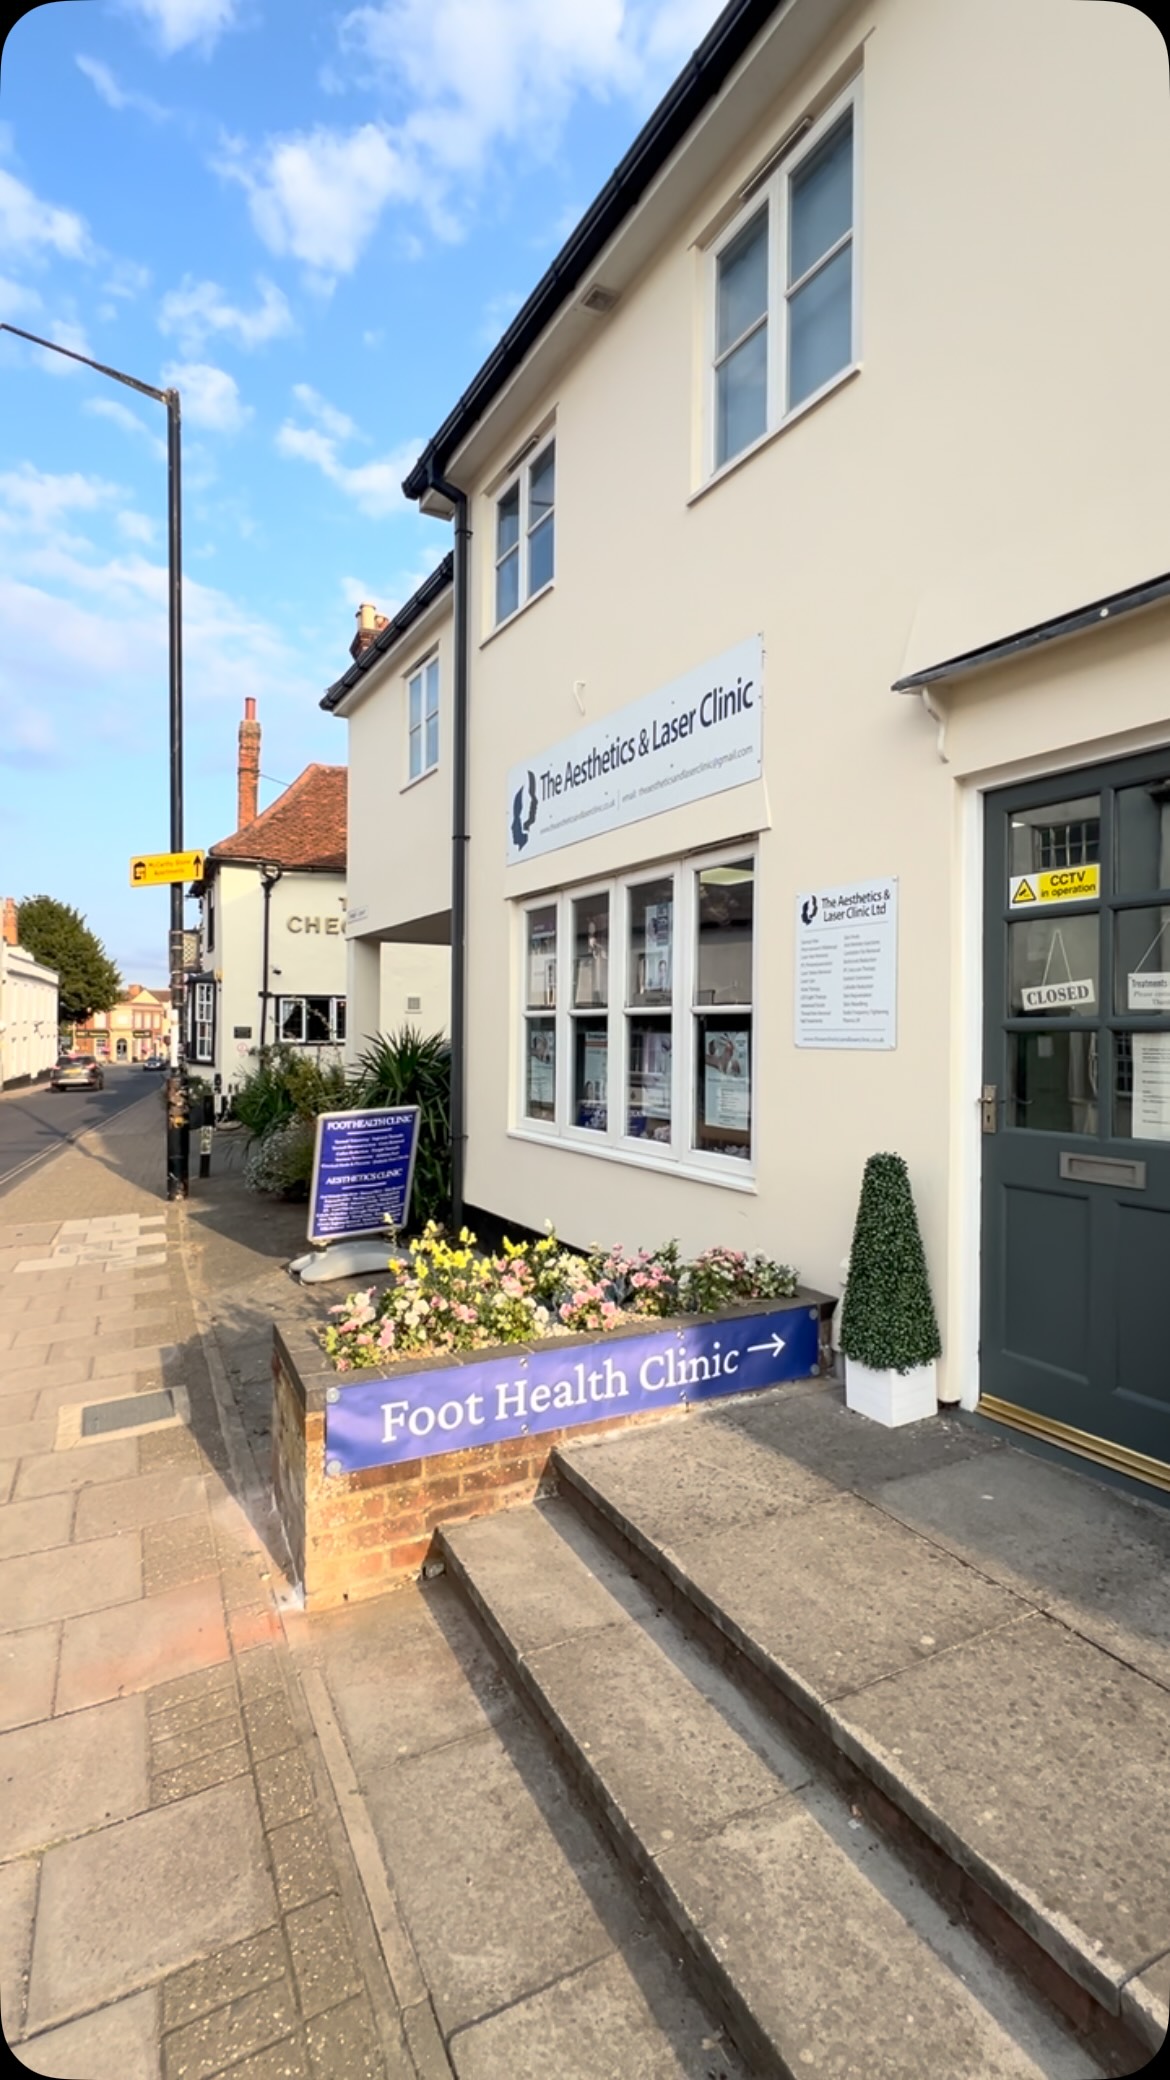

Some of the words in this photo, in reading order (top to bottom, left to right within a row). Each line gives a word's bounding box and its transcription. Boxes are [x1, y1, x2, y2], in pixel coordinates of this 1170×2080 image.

[540, 770, 562, 802] The
[564, 736, 635, 792] Aesthetics
[638, 728, 650, 757] &
[652, 707, 697, 751] Laser
[699, 677, 754, 728] Clinic
[1050, 871, 1086, 886] CCTV
[821, 896, 836, 909] The
[838, 890, 882, 906] Aesthetics
[884, 888, 890, 900] &
[1041, 888, 1049, 897] in
[1051, 883, 1096, 897] operation
[823, 911, 845, 922] Laser
[846, 905, 870, 919] Clinic
[871, 901, 887, 916] Ltd
[1026, 985, 1090, 1005] CLOSED
[327, 1120, 352, 1131] FOOT
[352, 1117, 386, 1128] HEALTH
[386, 1114, 413, 1126] CLINIC
[325, 1171, 376, 1185] AESTHETICS
[376, 1168, 403, 1179] CLINIC
[380, 1394, 485, 1444] Foot
[494, 1357, 628, 1421] Health
[638, 1341, 740, 1394] Clinic
